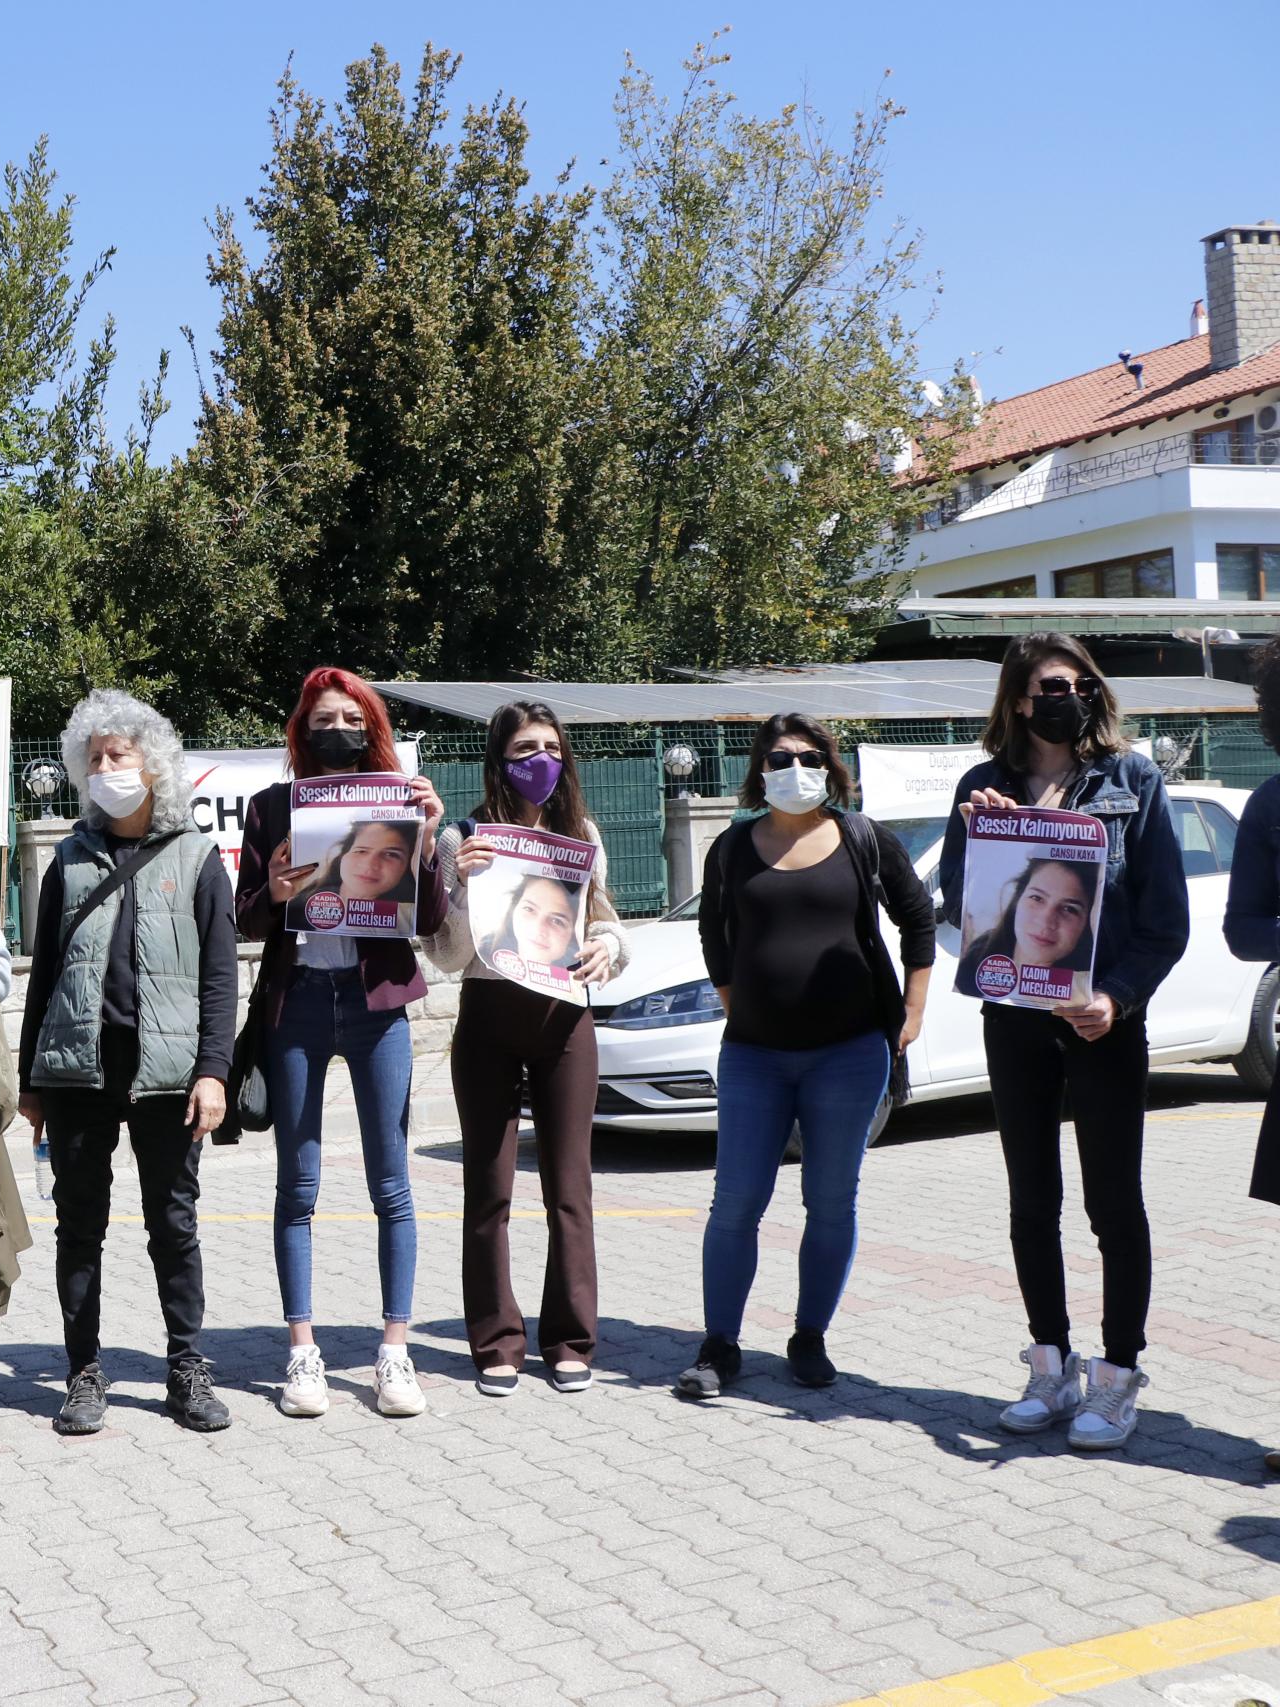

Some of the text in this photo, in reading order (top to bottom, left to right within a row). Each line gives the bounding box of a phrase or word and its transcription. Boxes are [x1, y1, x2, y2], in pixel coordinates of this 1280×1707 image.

[299, 784, 339, 802] Sessiz
[191, 796, 244, 833] CH
[371, 809, 415, 820] CANSU KAYA
[976, 816, 1098, 841] Sessiz Kalmıyoruz!
[518, 837, 588, 865] Kalmıyoruz!
[1050, 847, 1096, 860] CANSU KAYA
[563, 870, 581, 881] KAYA
[349, 900, 375, 912] KADIN
[348, 913, 396, 927] MECLİSLERİ
[1022, 966, 1050, 981] KADIN
[1020, 981, 1071, 998] MECLİSLERİ
